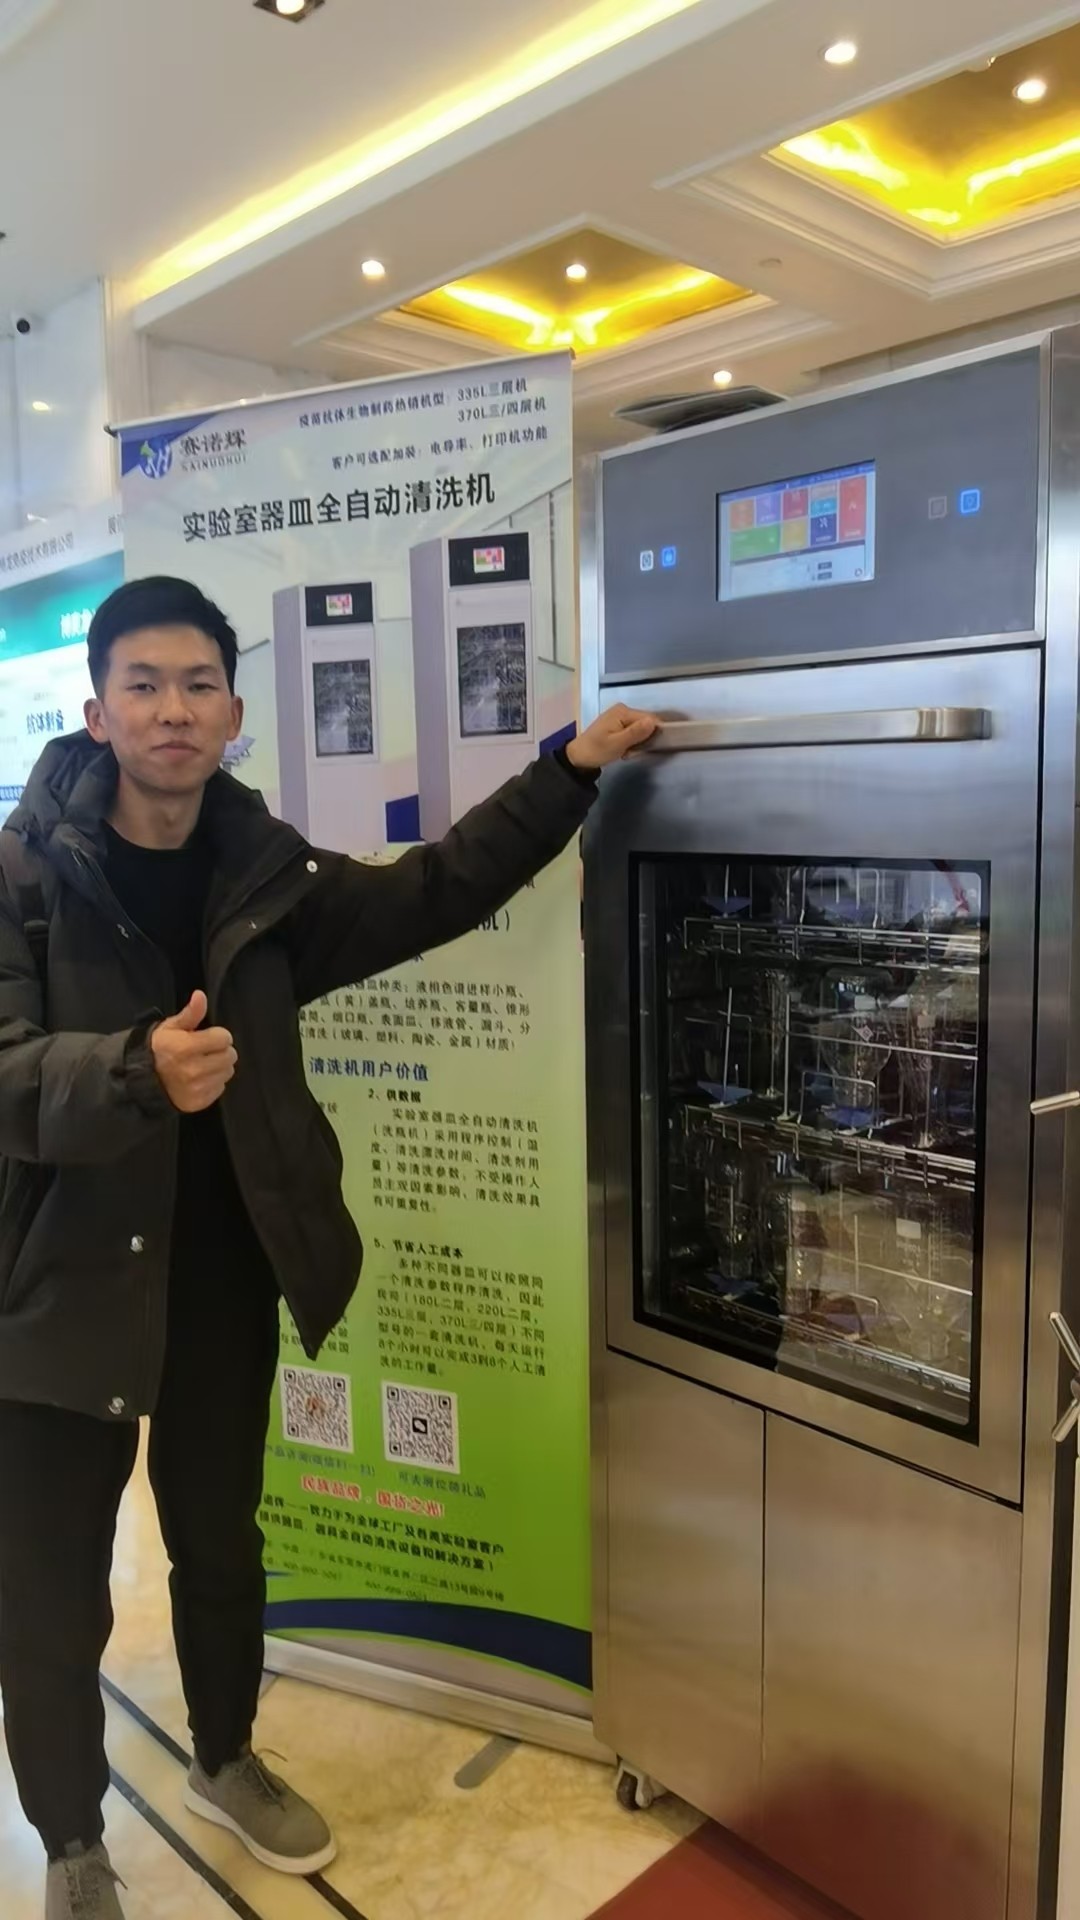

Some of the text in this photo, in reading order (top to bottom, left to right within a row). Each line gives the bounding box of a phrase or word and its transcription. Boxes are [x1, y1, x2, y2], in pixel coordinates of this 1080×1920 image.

[183, 472, 496, 543] 实验室器皿全自动清洗机
[309, 1056, 429, 1082] 清洗机用户价值
